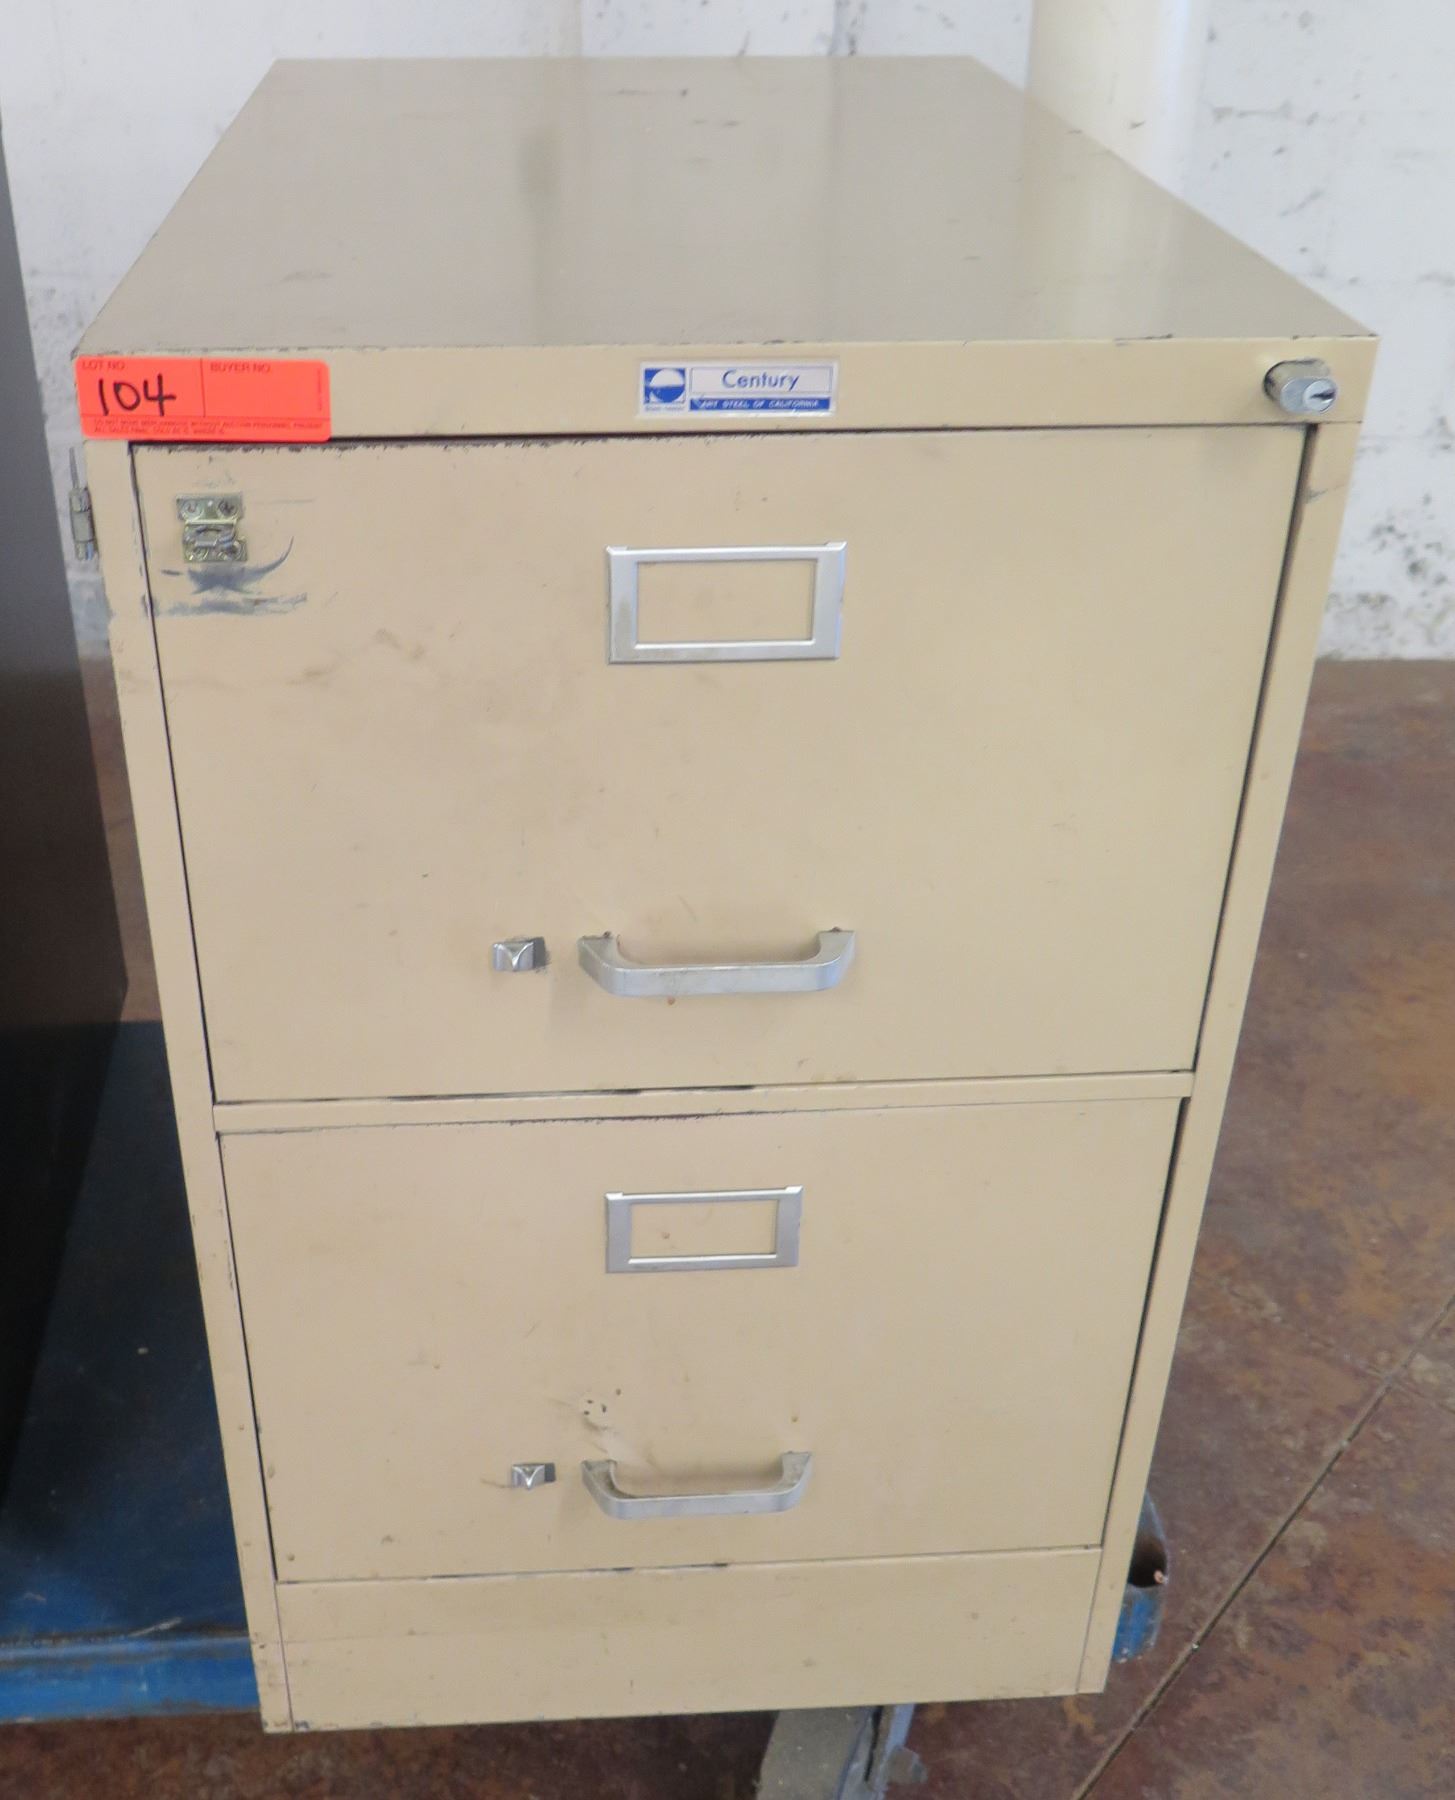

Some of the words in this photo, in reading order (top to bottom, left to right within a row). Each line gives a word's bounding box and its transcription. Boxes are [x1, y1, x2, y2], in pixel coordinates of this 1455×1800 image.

[82, 360, 103, 370] LOT
[210, 362, 250, 373] BUYER
[721, 368, 800, 391] Century
[98, 373, 177, 416] 104
